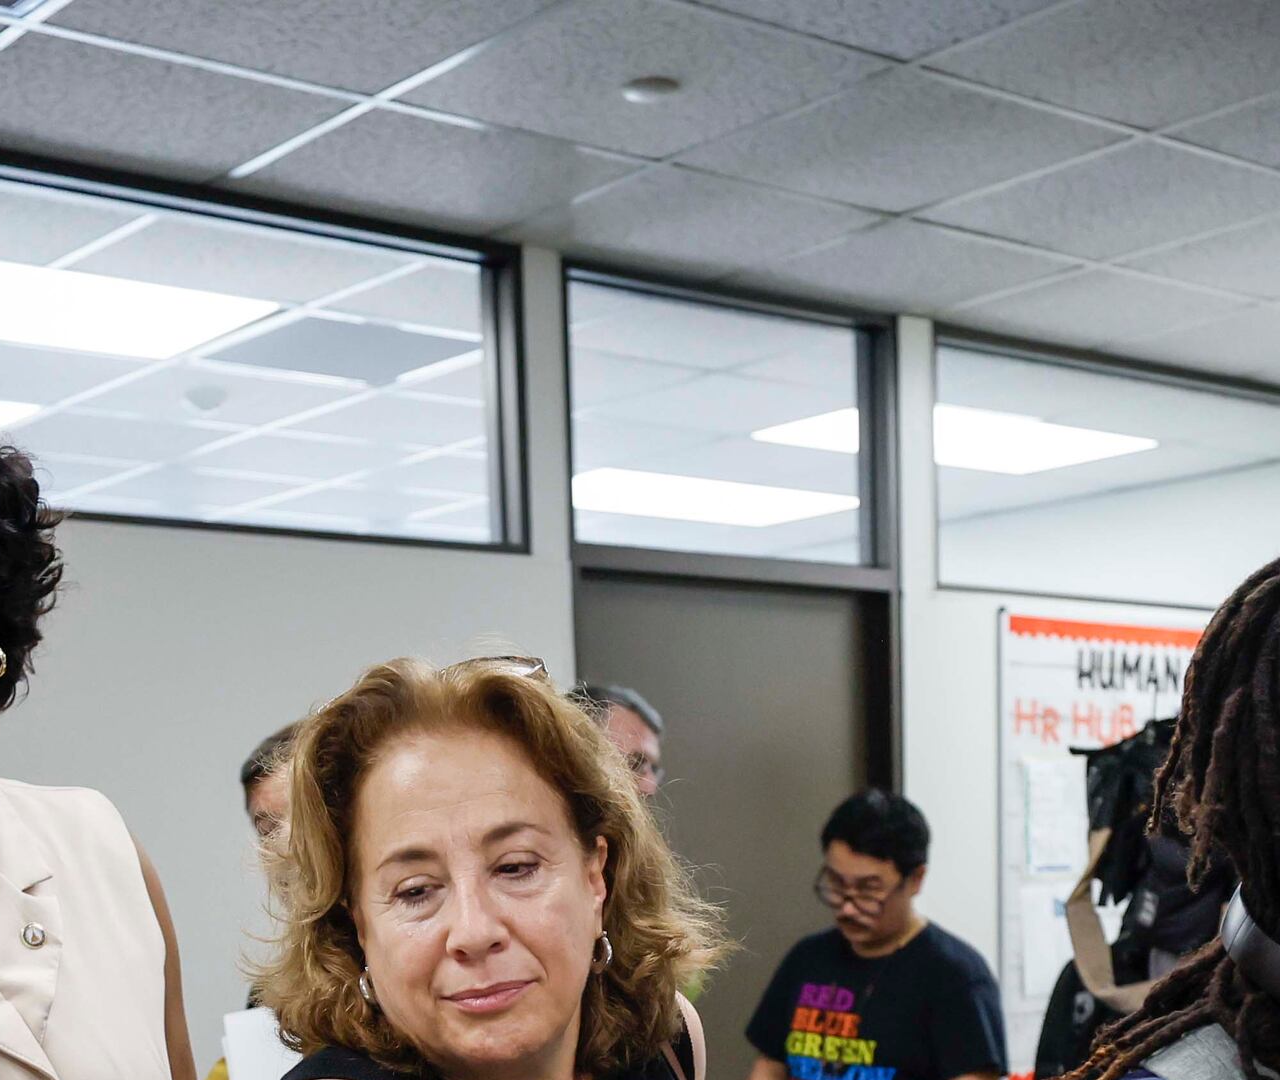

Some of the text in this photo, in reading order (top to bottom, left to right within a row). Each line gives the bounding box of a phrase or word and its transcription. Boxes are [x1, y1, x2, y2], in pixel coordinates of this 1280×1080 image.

[1077, 648, 1182, 692] HUMAN
[1014, 698, 1138, 747] HR HUB
[798, 983, 855, 1011] RED
[790, 1007, 861, 1037] BLUE
[785, 1031, 877, 1066] GREEN
